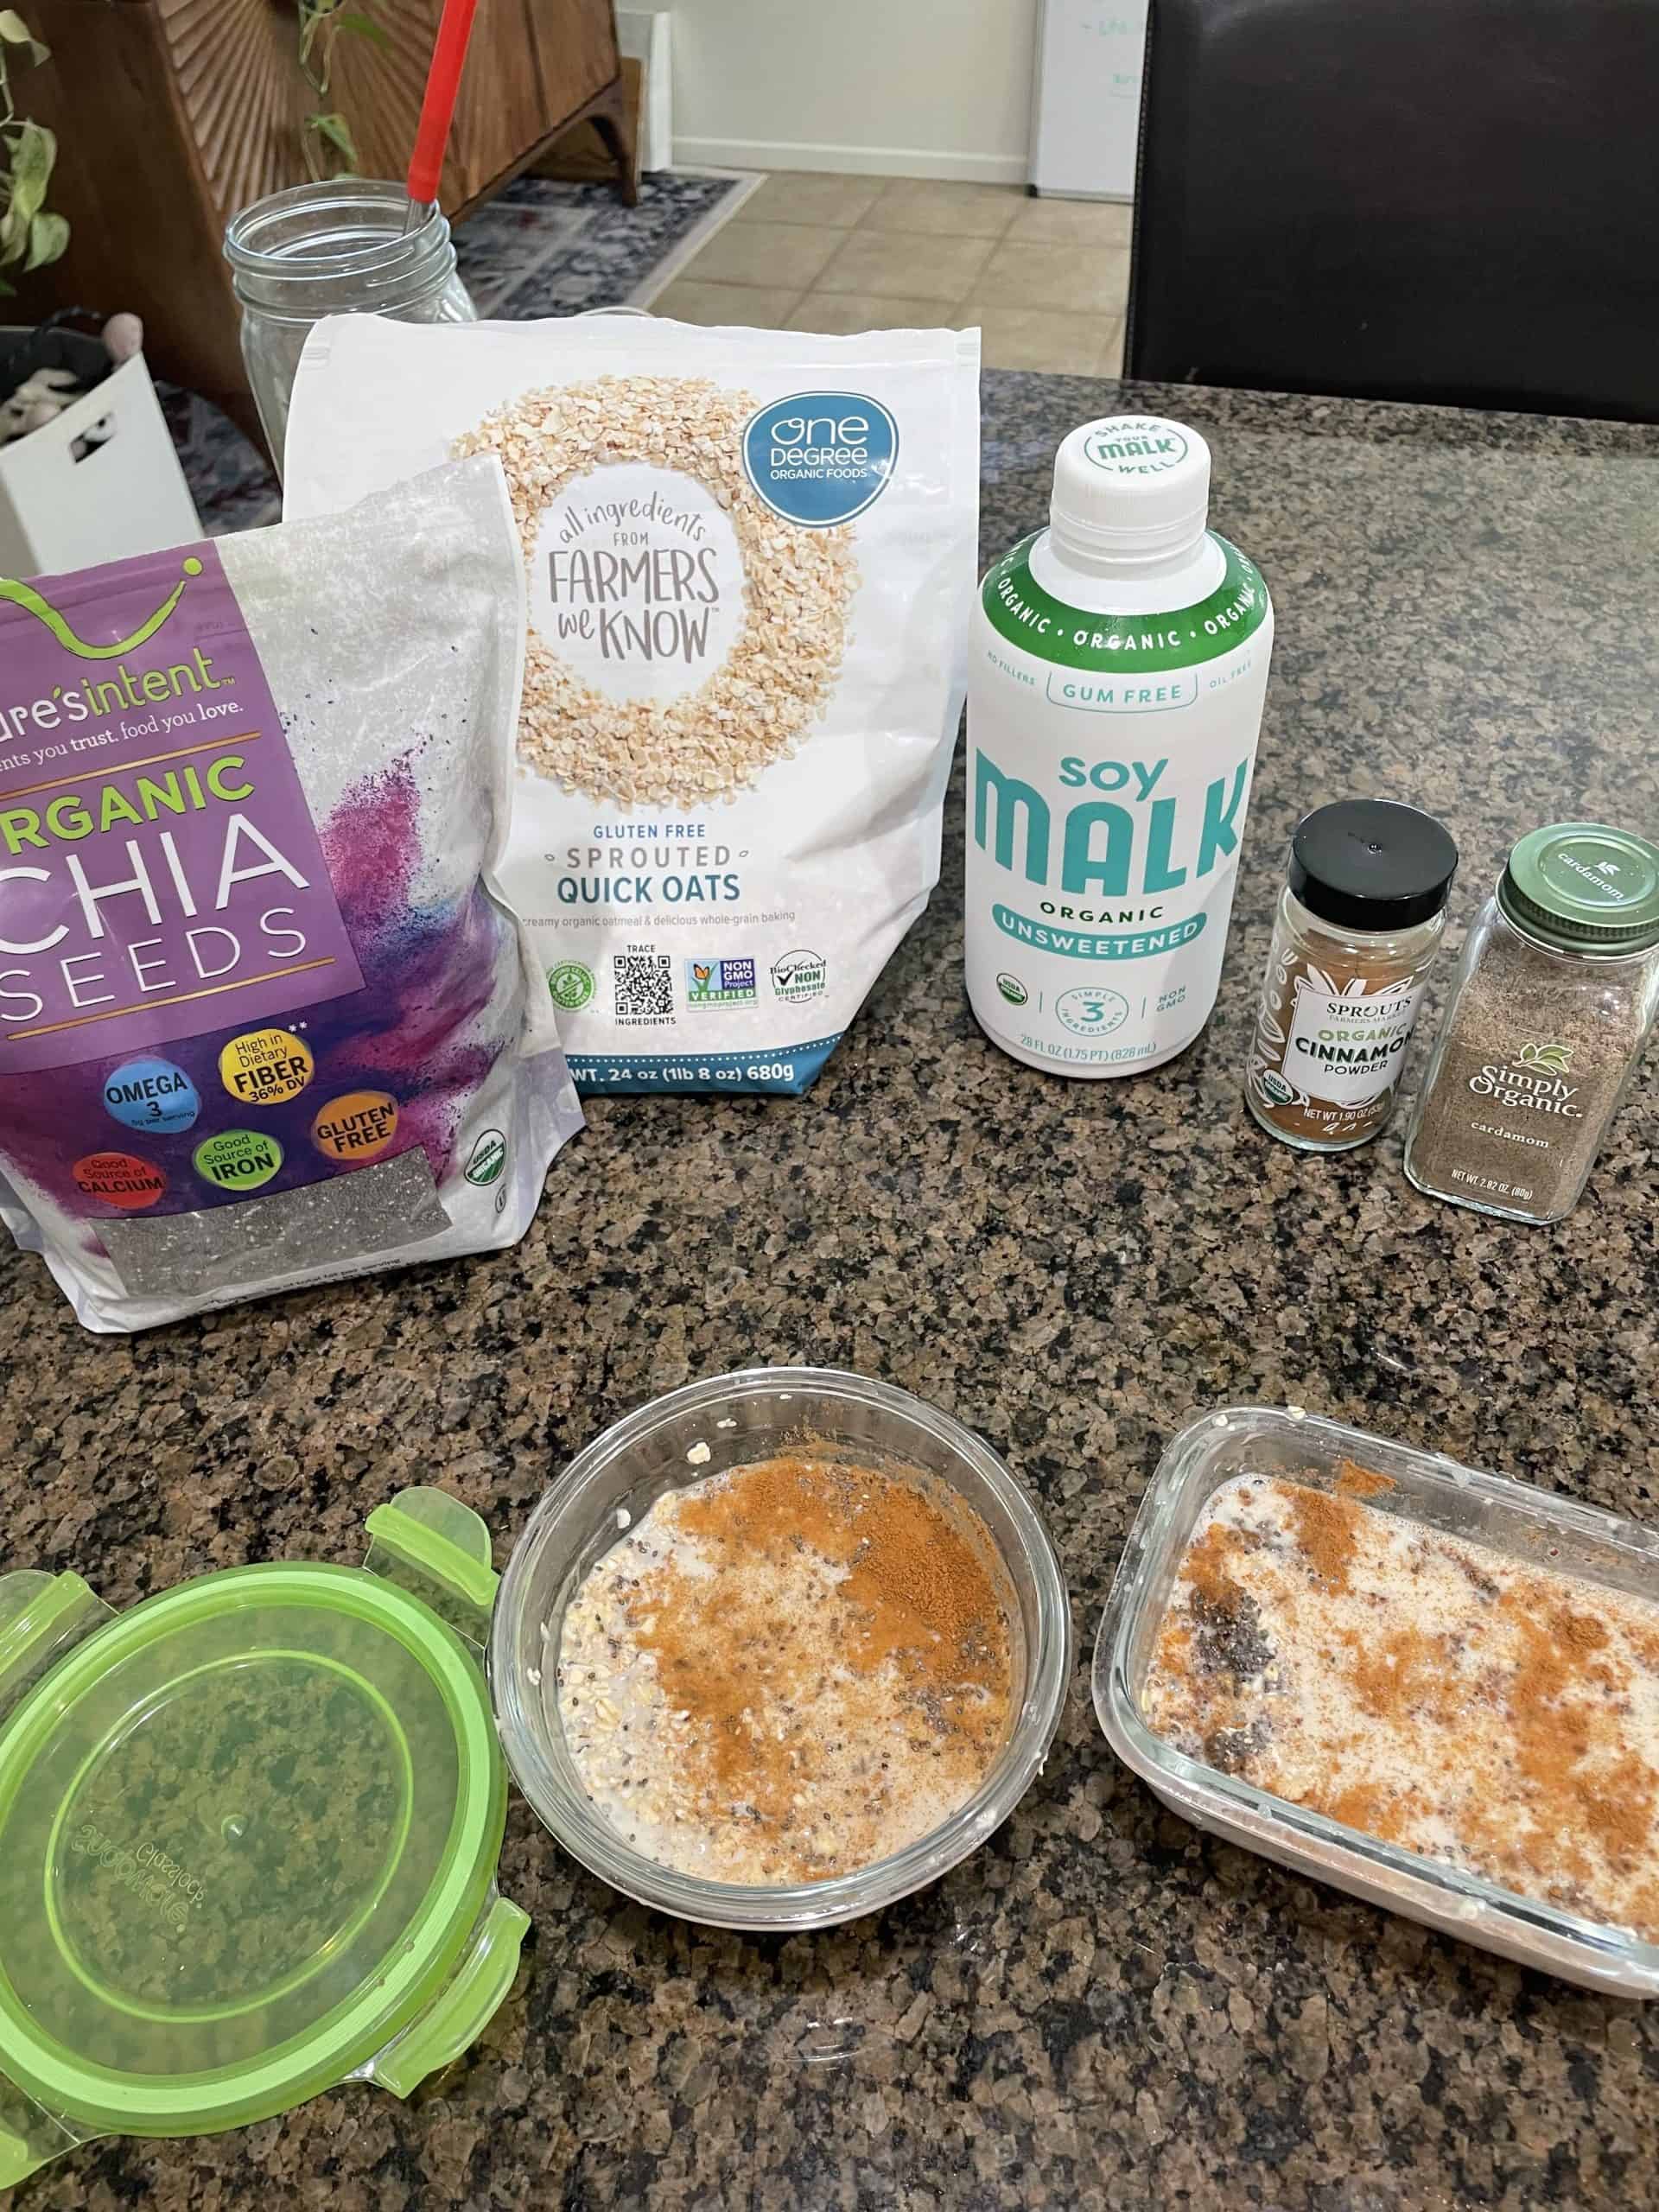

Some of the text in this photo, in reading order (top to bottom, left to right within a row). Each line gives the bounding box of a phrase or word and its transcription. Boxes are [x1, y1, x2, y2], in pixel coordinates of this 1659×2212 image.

[1095, 423, 1161, 437] SHAKE
[771, 468, 868, 480] ORGANIC FOODS
[1118, 461, 1175, 474] WELL
[560, 491, 706, 543] all ingredients
[613, 532, 648, 546] FROM
[549, 548, 719, 604] FARMERS
[998, 577, 1052, 633] ORGANIC
[1073, 630, 1181, 651] ORGANIC
[558, 607, 709, 664] we KNOW
[1063, 683, 1182, 704] GUM FREE
[33, 744, 68, 765] you
[120, 715, 159, 741] food
[162, 715, 196, 734] you
[199, 701, 243, 719] love.
[0, 756, 255, 854] RGANIC
[594, 824, 706, 838] GLUTEN FREE
[567, 846, 730, 868] SPROUTED
[0, 814, 310, 955] CHIA
[1558, 853, 1624, 899] cardamom
[557, 874, 741, 903] QUICK OATS
[563, 916, 600, 930] organic
[602, 916, 642, 926] oatmeal
[654, 912, 697, 926] delicious
[700, 912, 759, 926] whole-grain
[761, 910, 795, 925] baking
[1039, 901, 1164, 924] ORGANIC
[1001, 911, 1198, 955] UNSWEETENED
[0, 907, 306, 1021] SEEDS
[724, 961, 752, 971] NON
[769, 959, 827, 974] BioChecked
[724, 970, 753, 981] GMO
[724, 980, 753, 989] Project
[794, 971, 820, 983] NON
[691, 989, 754, 1001] VERIFIED
[1071, 991, 1116, 1002] SIMPLE
[1156, 995, 1185, 1013] GMO
[1159, 986, 1186, 1003] NON
[1080, 1001, 1104, 1022] 3
[1327, 995, 1412, 1017] SPROUTS
[615, 1016, 677, 1026] INGREDIENTS
[1061, 1008, 1122, 1033] INGREDIENTS
[1318, 1023, 1407, 1041] ORGANIC
[235, 1033, 283, 1055] High in
[1021, 1036, 1033, 1047] 28
[1035, 1039, 1046, 1052] FL
[1048, 1044, 1062, 1056] OZ
[1064, 1047, 1088, 1059] (1.75
[1090, 1049, 1109, 1061] PT)
[1111, 1049, 1135, 1061] (828
[1296, 1024, 1414, 1063] CINNAMON
[239, 1046, 288, 1068] Dietary
[1324, 1059, 1388, 1075] POWDER
[233, 1056, 308, 1093] FIBER
[569, 1068, 605, 1082] WT.
[607, 1068, 632, 1081] 24
[637, 1071, 658, 1079] oz
[697, 1067, 710, 1080] 8
[715, 1068, 742, 1082] oz)
[747, 1064, 794, 1081] 680g
[1481, 1065, 1580, 1102] Simply
[106, 1072, 188, 1104] OMEGA
[249, 1076, 305, 1103] 36% DV
[146, 1101, 162, 1117] 3
[1304, 1108, 1321, 1119] NET
[1323, 1111, 1338, 1121] WT
[317, 1103, 395, 1140] GLUTEN
[213, 1135, 251, 1152] Good
[334, 1123, 391, 1153] FREE
[1471, 1122, 1549, 1148] cardamom
[91, 1159, 129, 1169] Good
[204, 1141, 269, 1165] Source of
[84, 1167, 147, 1179] Source of
[211, 1153, 275, 1181] IRON
[77, 1177, 164, 1193] CALCIUM
[1452, 1169, 1466, 1181] NET
[1480, 1178, 1497, 1191] 2.82
[1511, 1186, 1533, 1200] (80g)
